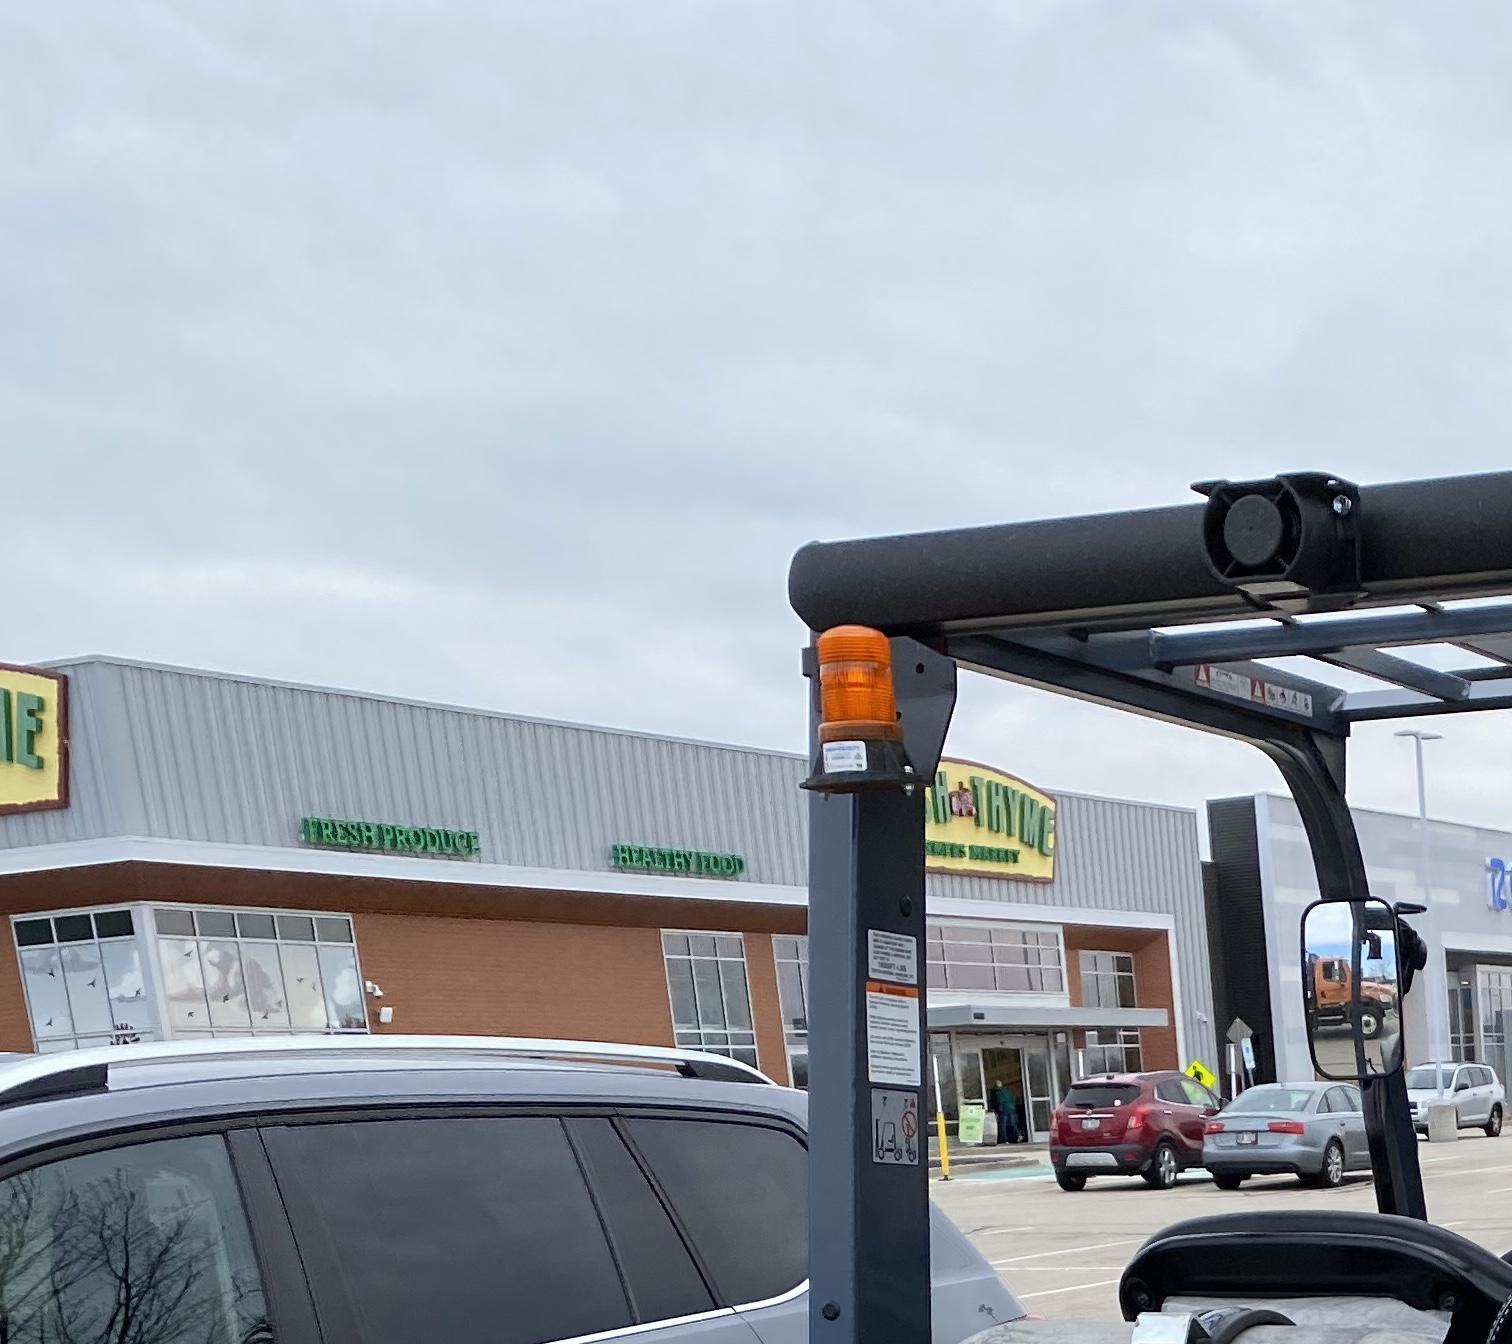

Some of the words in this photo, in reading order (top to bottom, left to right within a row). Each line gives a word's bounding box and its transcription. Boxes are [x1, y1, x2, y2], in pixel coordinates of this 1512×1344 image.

[969, 775, 1054, 857] THYME
[302, 817, 375, 849] FRESH
[381, 825, 480, 857] PRODUCE
[612, 844, 693, 871] HEALTHY
[697, 853, 745, 876] FOOD
